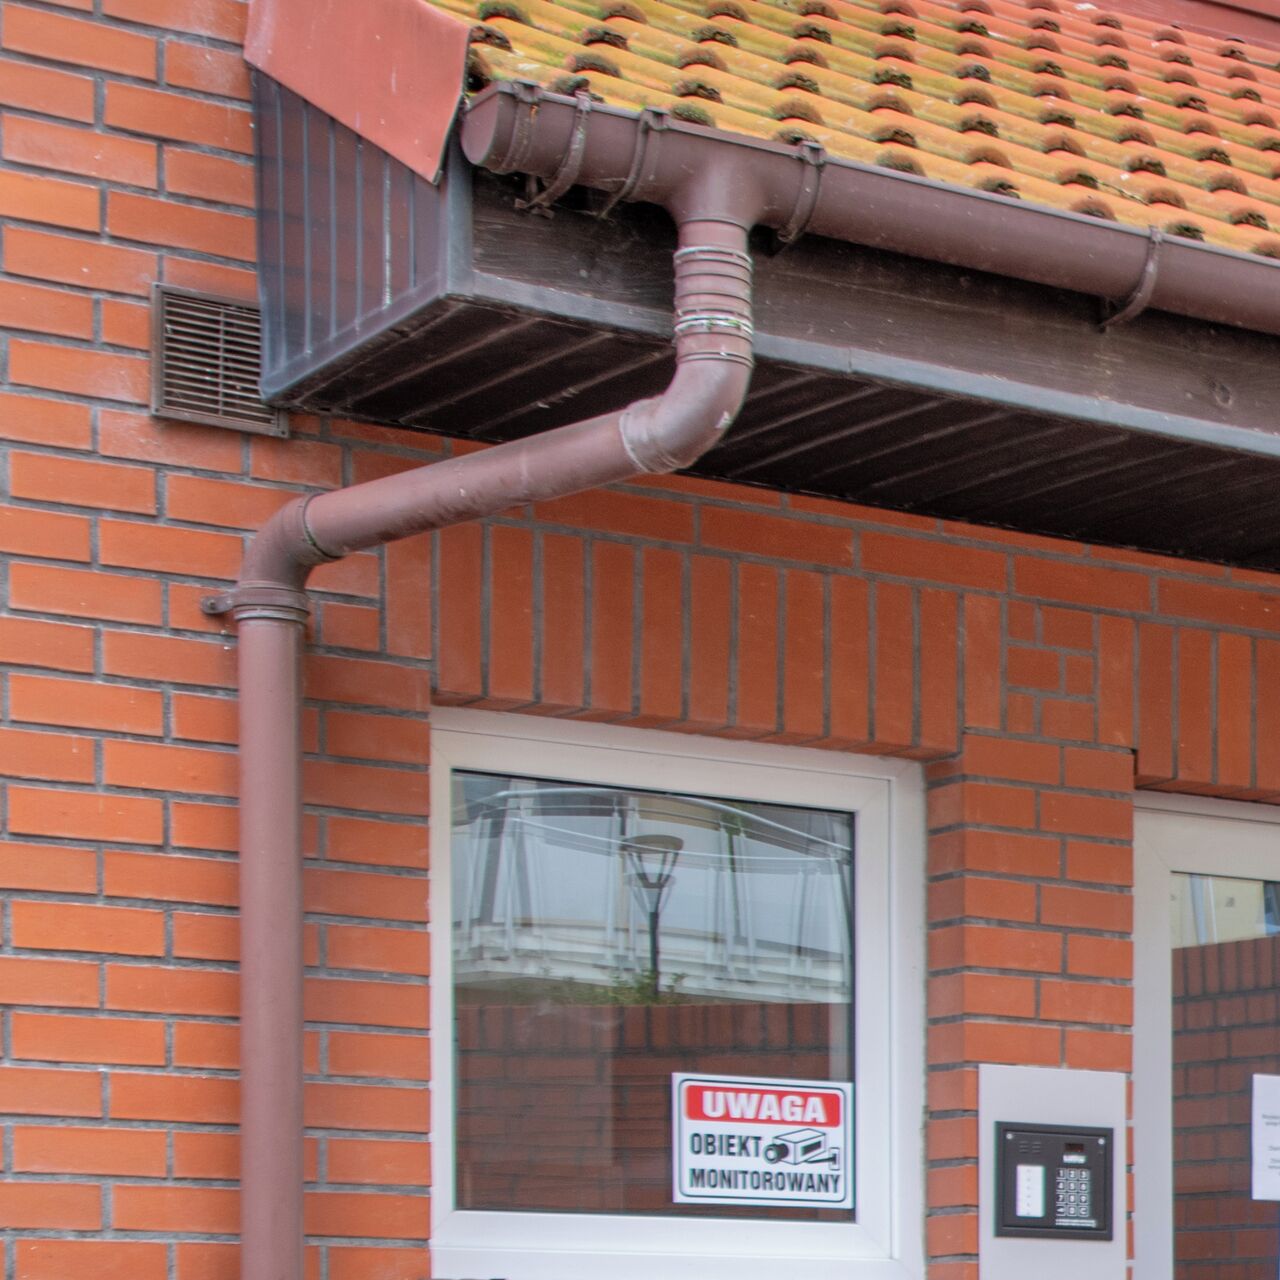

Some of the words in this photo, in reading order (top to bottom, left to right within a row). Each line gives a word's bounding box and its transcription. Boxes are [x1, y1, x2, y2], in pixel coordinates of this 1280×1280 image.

[701, 1090, 828, 1123] UWAGA
[689, 1132, 763, 1157] OBIEKT
[688, 1167, 841, 1194] MONITOROWANY
